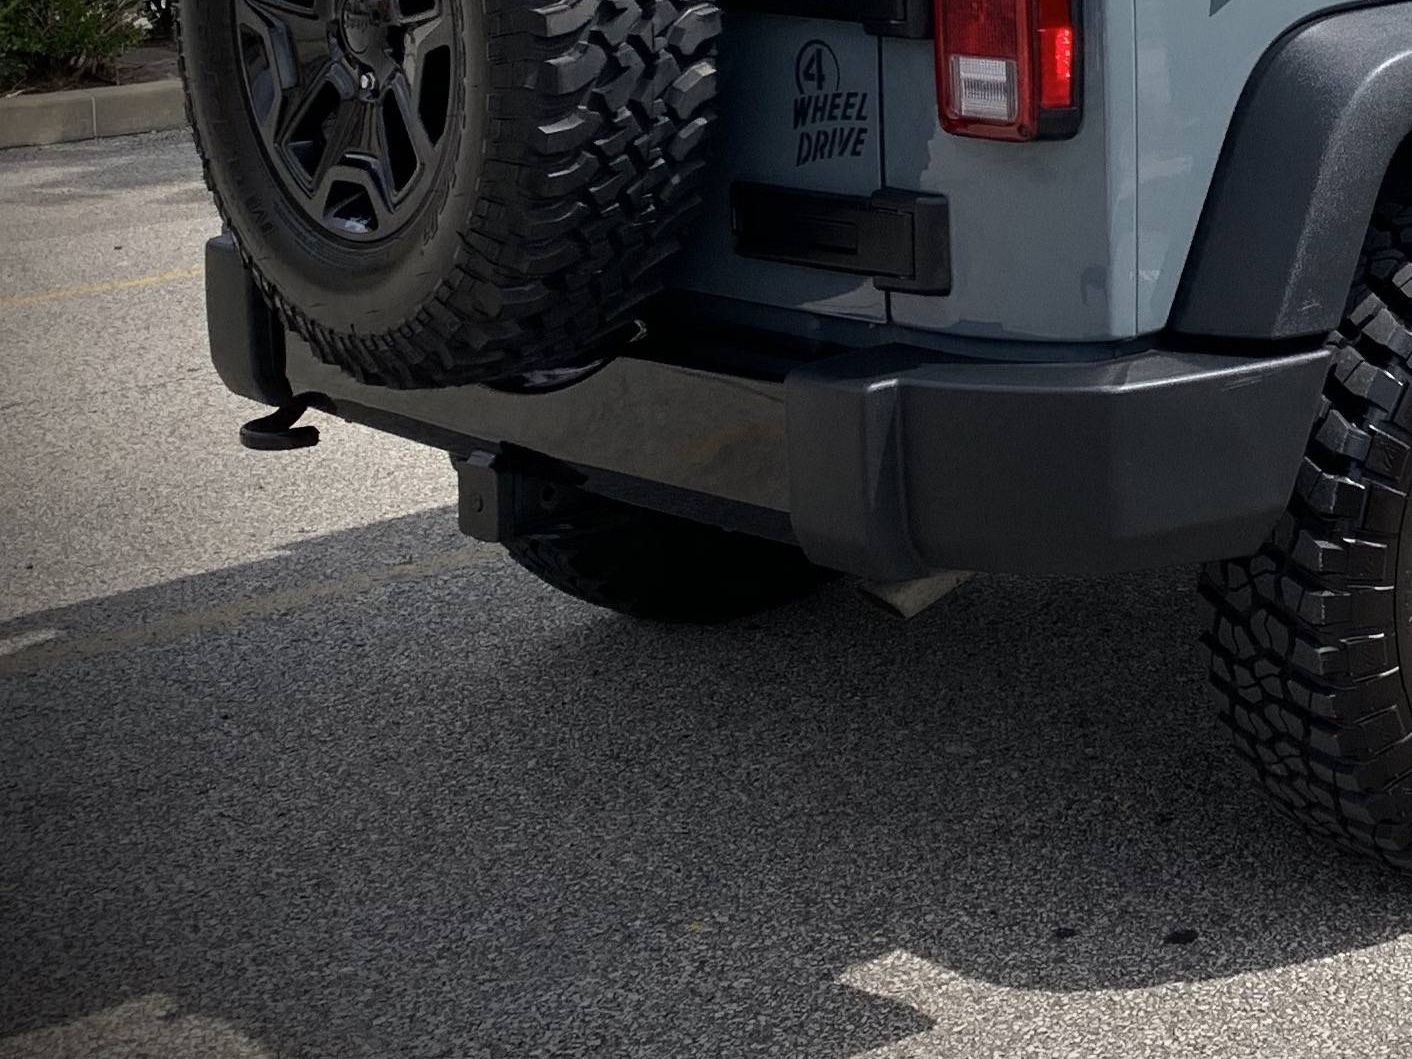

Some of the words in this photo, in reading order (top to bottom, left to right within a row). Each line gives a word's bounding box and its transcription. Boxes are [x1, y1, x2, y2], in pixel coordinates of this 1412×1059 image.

[803, 48, 826, 91] 4
[793, 92, 868, 130] WHEEL
[796, 127, 868, 167] DRIVE
